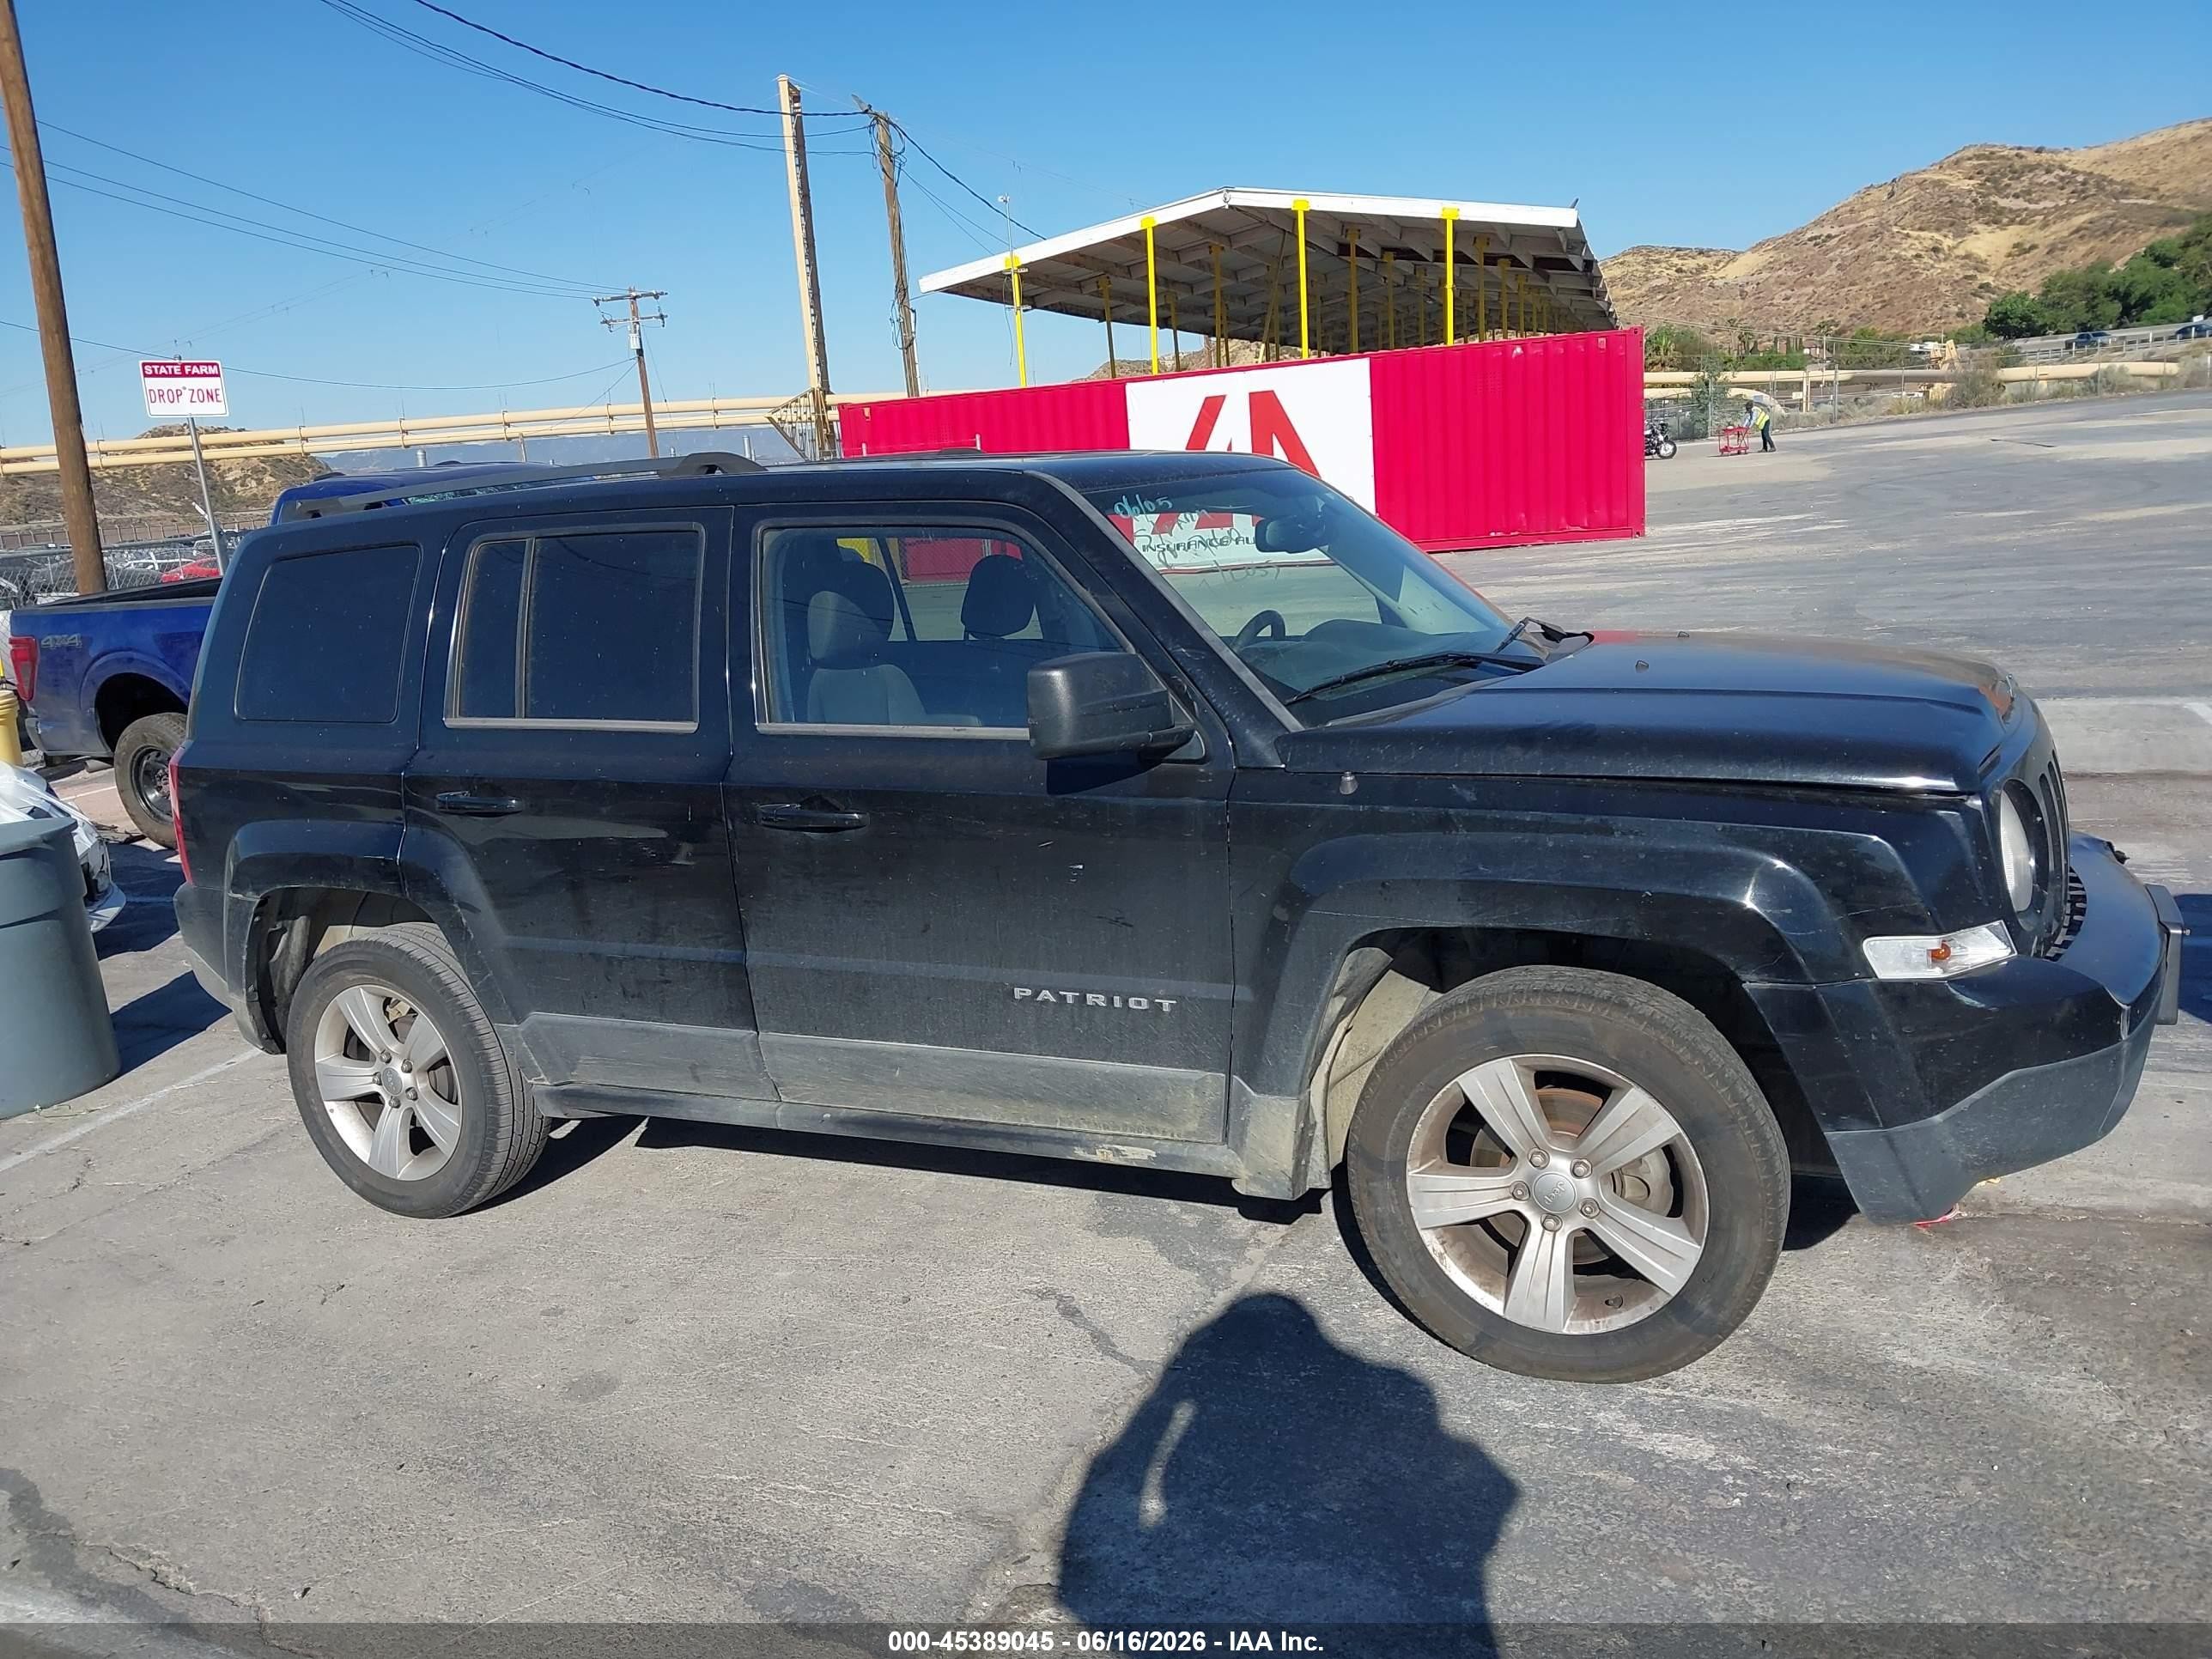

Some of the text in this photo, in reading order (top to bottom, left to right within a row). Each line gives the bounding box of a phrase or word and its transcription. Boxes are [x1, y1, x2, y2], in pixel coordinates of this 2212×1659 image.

[144, 364, 219, 375] STATE FARM
[149, 388, 222, 404] DROP ZONE
[1142, 535, 1229, 552] INSURANCE
[1013, 987, 1177, 1012] PATRIOT
[1543, 1181, 1566, 1205] Jeep
